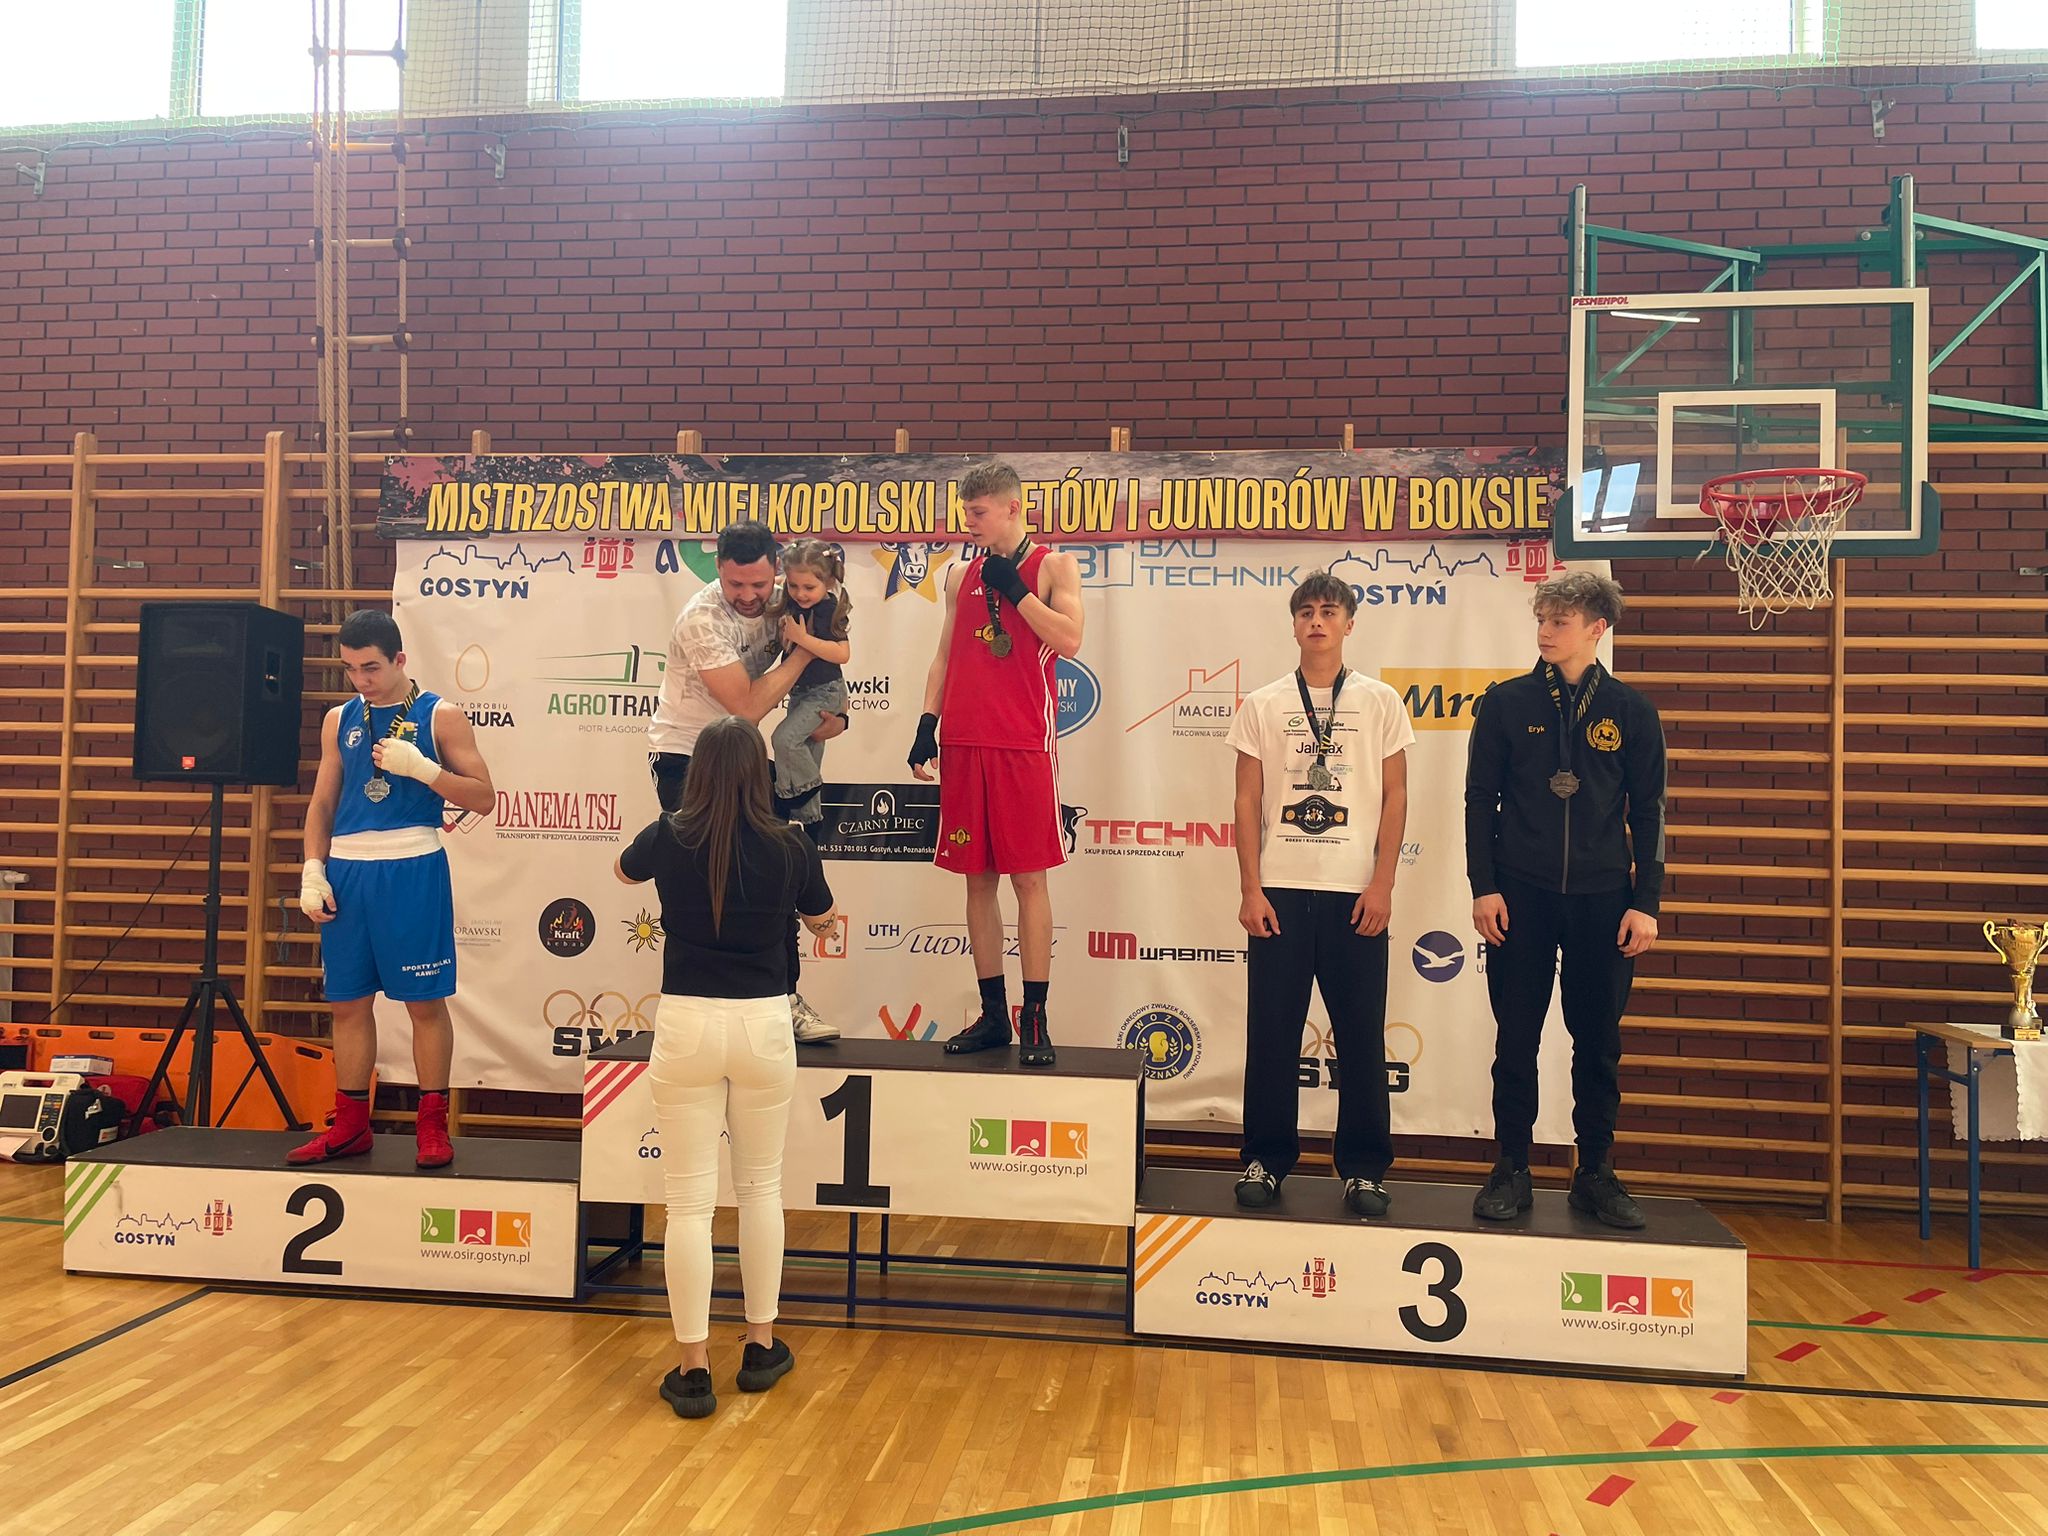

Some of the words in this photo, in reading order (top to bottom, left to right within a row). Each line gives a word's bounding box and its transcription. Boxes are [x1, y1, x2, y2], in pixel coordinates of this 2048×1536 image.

[425, 481, 674, 533] MISTRZOSTWA
[946, 467, 1118, 535] KETÓW
[1127, 478, 1140, 533] I
[1148, 465, 1350, 532] JUNIORÓW
[1360, 476, 1399, 532] W
[1408, 475, 1550, 531] BOKSIE
[1140, 538, 1217, 558] BAU
[1140, 565, 1300, 587] TECHNIK
[420, 576, 530, 600] GOSTYŃ
[1347, 580, 1447, 606] OSTYŃ
[1058, 678, 1079, 698] NY
[1058, 700, 1077, 713] SKI
[1179, 705, 1232, 717] MACIEJ
[579, 725, 603, 733] PIOTR
[1528, 725, 1545, 734] Eryk
[495, 790, 582, 829] DANEMA
[584, 793, 622, 831] TSL
[838, 818, 890, 835] CZARNY
[894, 816, 925, 830] PIEC
[496, 832, 541, 840] TRANSPORT
[542, 833, 578, 842] SPEDYCJA
[578, 834, 620, 843] LOGISTYKA
[1127, 849, 1161, 857] SPRZEDAŻ
[1162, 850, 1184, 859] CIELĄT
[554, 930, 581, 939] Kraft
[868, 924, 900, 937] UTH
[402, 963, 431, 972] SPORTY
[1151, 1003, 1179, 1014] ZWIĄZEK
[1178, 1009, 1202, 1040] BOKSERSKI
[1145, 1065, 1180, 1079] OZNAŃ
[816, 1075, 891, 1209] 1
[969, 1160, 1089, 1177] www.osir.gostyn.pl
[114, 1230, 176, 1247] GOSTYŃ
[282, 1183, 345, 1276] 2
[420, 1247, 532, 1266] www.osir.gostyn.pl
[1195, 1291, 1270, 1310] GOSTYŃ
[1398, 1241, 1468, 1344] 3
[1561, 1315, 1696, 1338] www.osir.gostyn.pl
